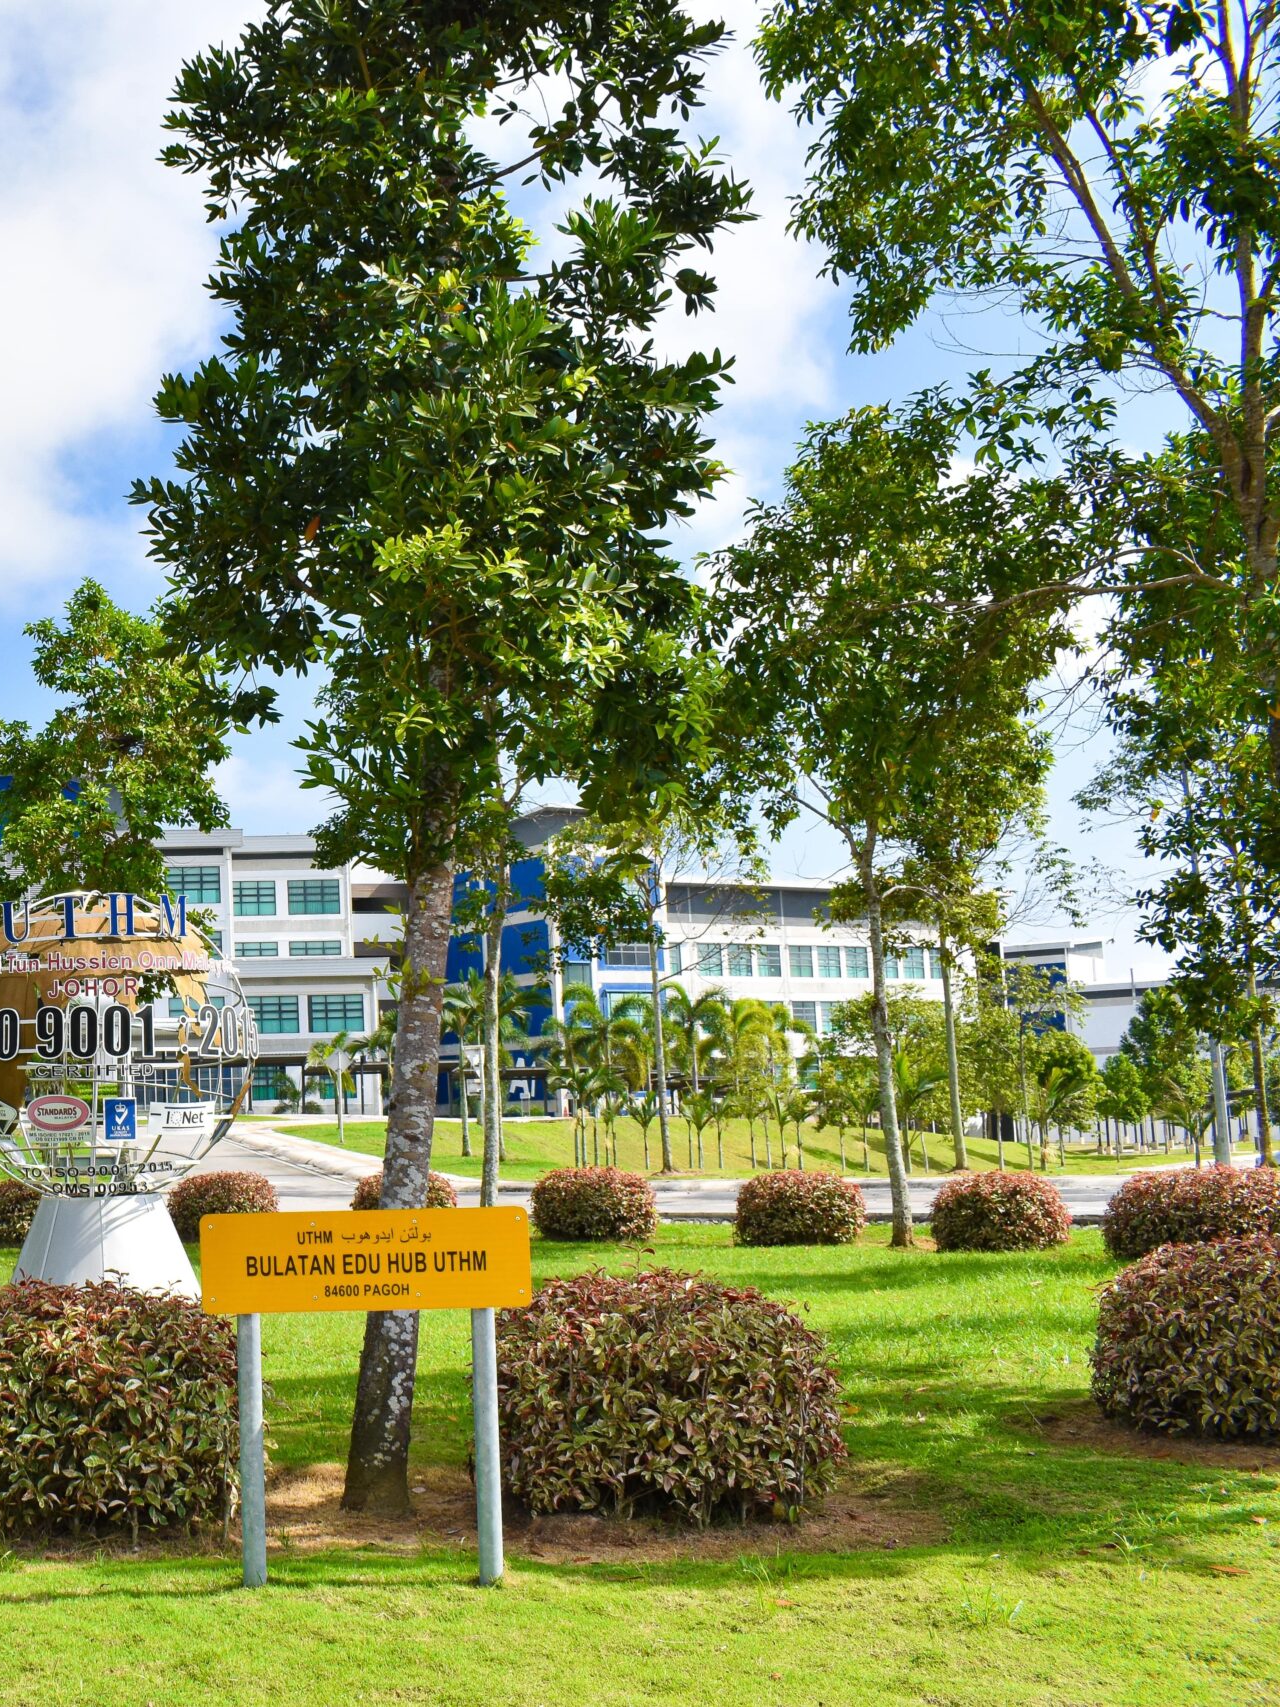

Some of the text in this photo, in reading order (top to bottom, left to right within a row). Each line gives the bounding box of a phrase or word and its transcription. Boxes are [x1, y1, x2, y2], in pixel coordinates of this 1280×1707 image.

[0, 893, 188, 943] UTHM
[7, 954, 41, 973] Tun
[47, 950, 133, 972] Hussien
[138, 950, 178, 970] Onn
[47, 976, 138, 999] JOHOR
[35, 1064, 155, 1078] CERTIFIED
[37, 1107, 77, 1116] STANDARDS
[22, 1167, 42, 1179] TO
[49, 1166, 79, 1178] ISO
[52, 1181, 149, 1195] QMS 00953
[297, 1231, 333, 1245] UTHM
[246, 1249, 488, 1277] BULATAN EDU HUB UTHM
[324, 1283, 410, 1298] 84600 PAGOH
